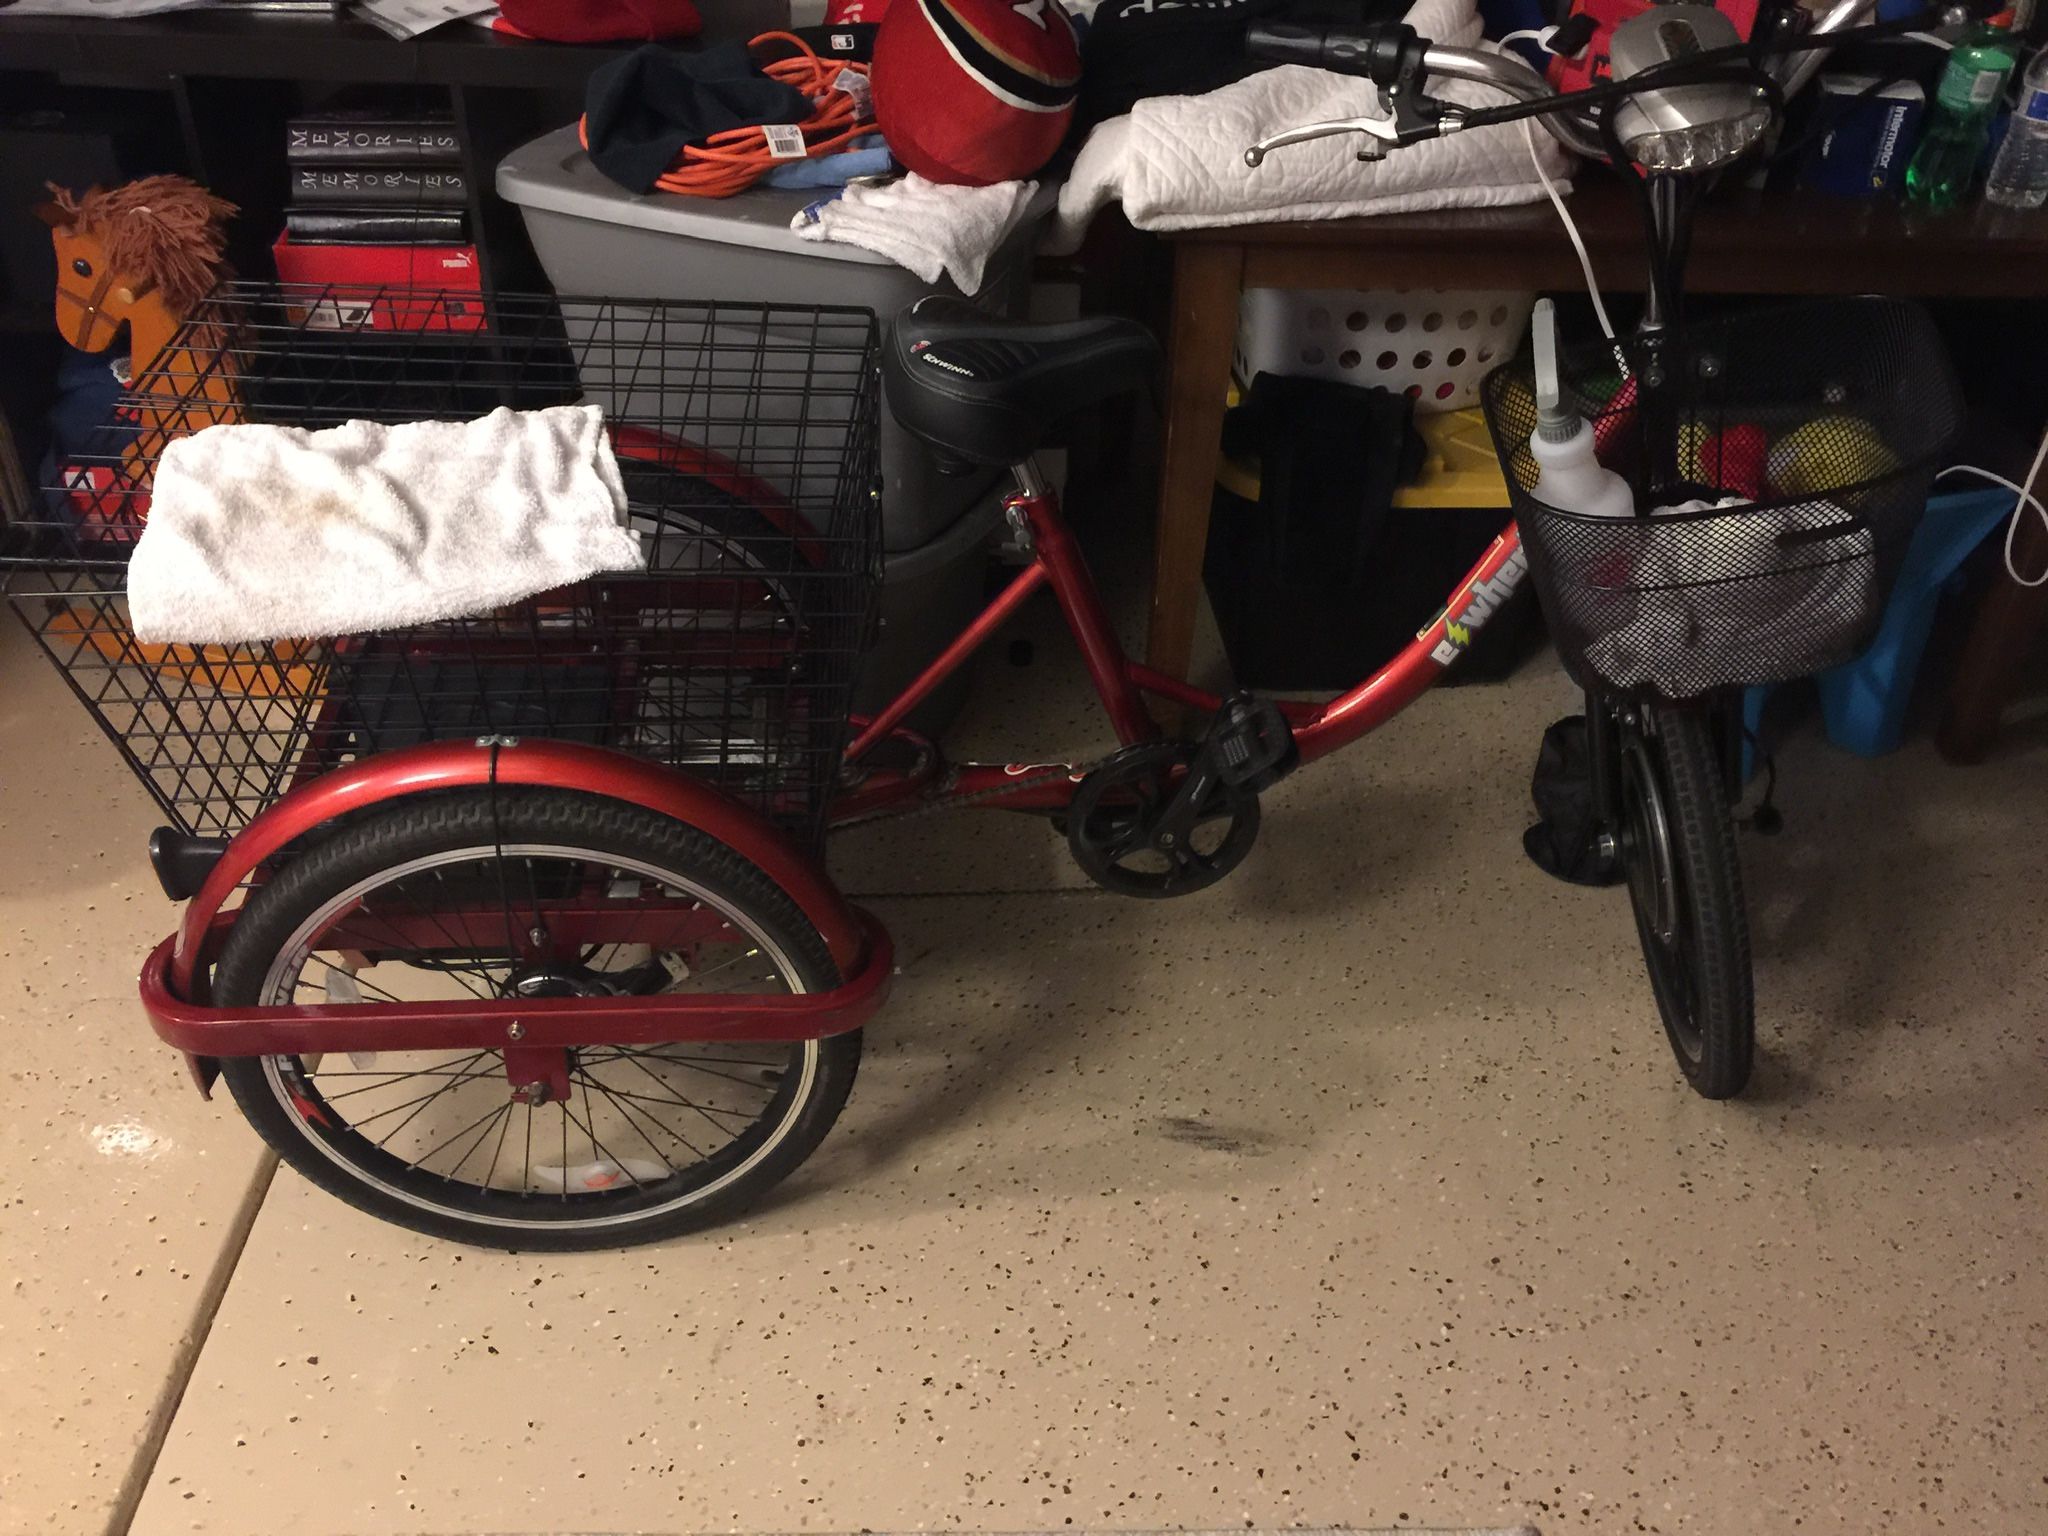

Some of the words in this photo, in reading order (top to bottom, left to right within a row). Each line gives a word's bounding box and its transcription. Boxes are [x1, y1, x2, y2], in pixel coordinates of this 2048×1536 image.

[291, 129, 455, 148] MEMORIES
[1879, 105, 1908, 169] Intermotor
[301, 171, 463, 190] MEMORIES
